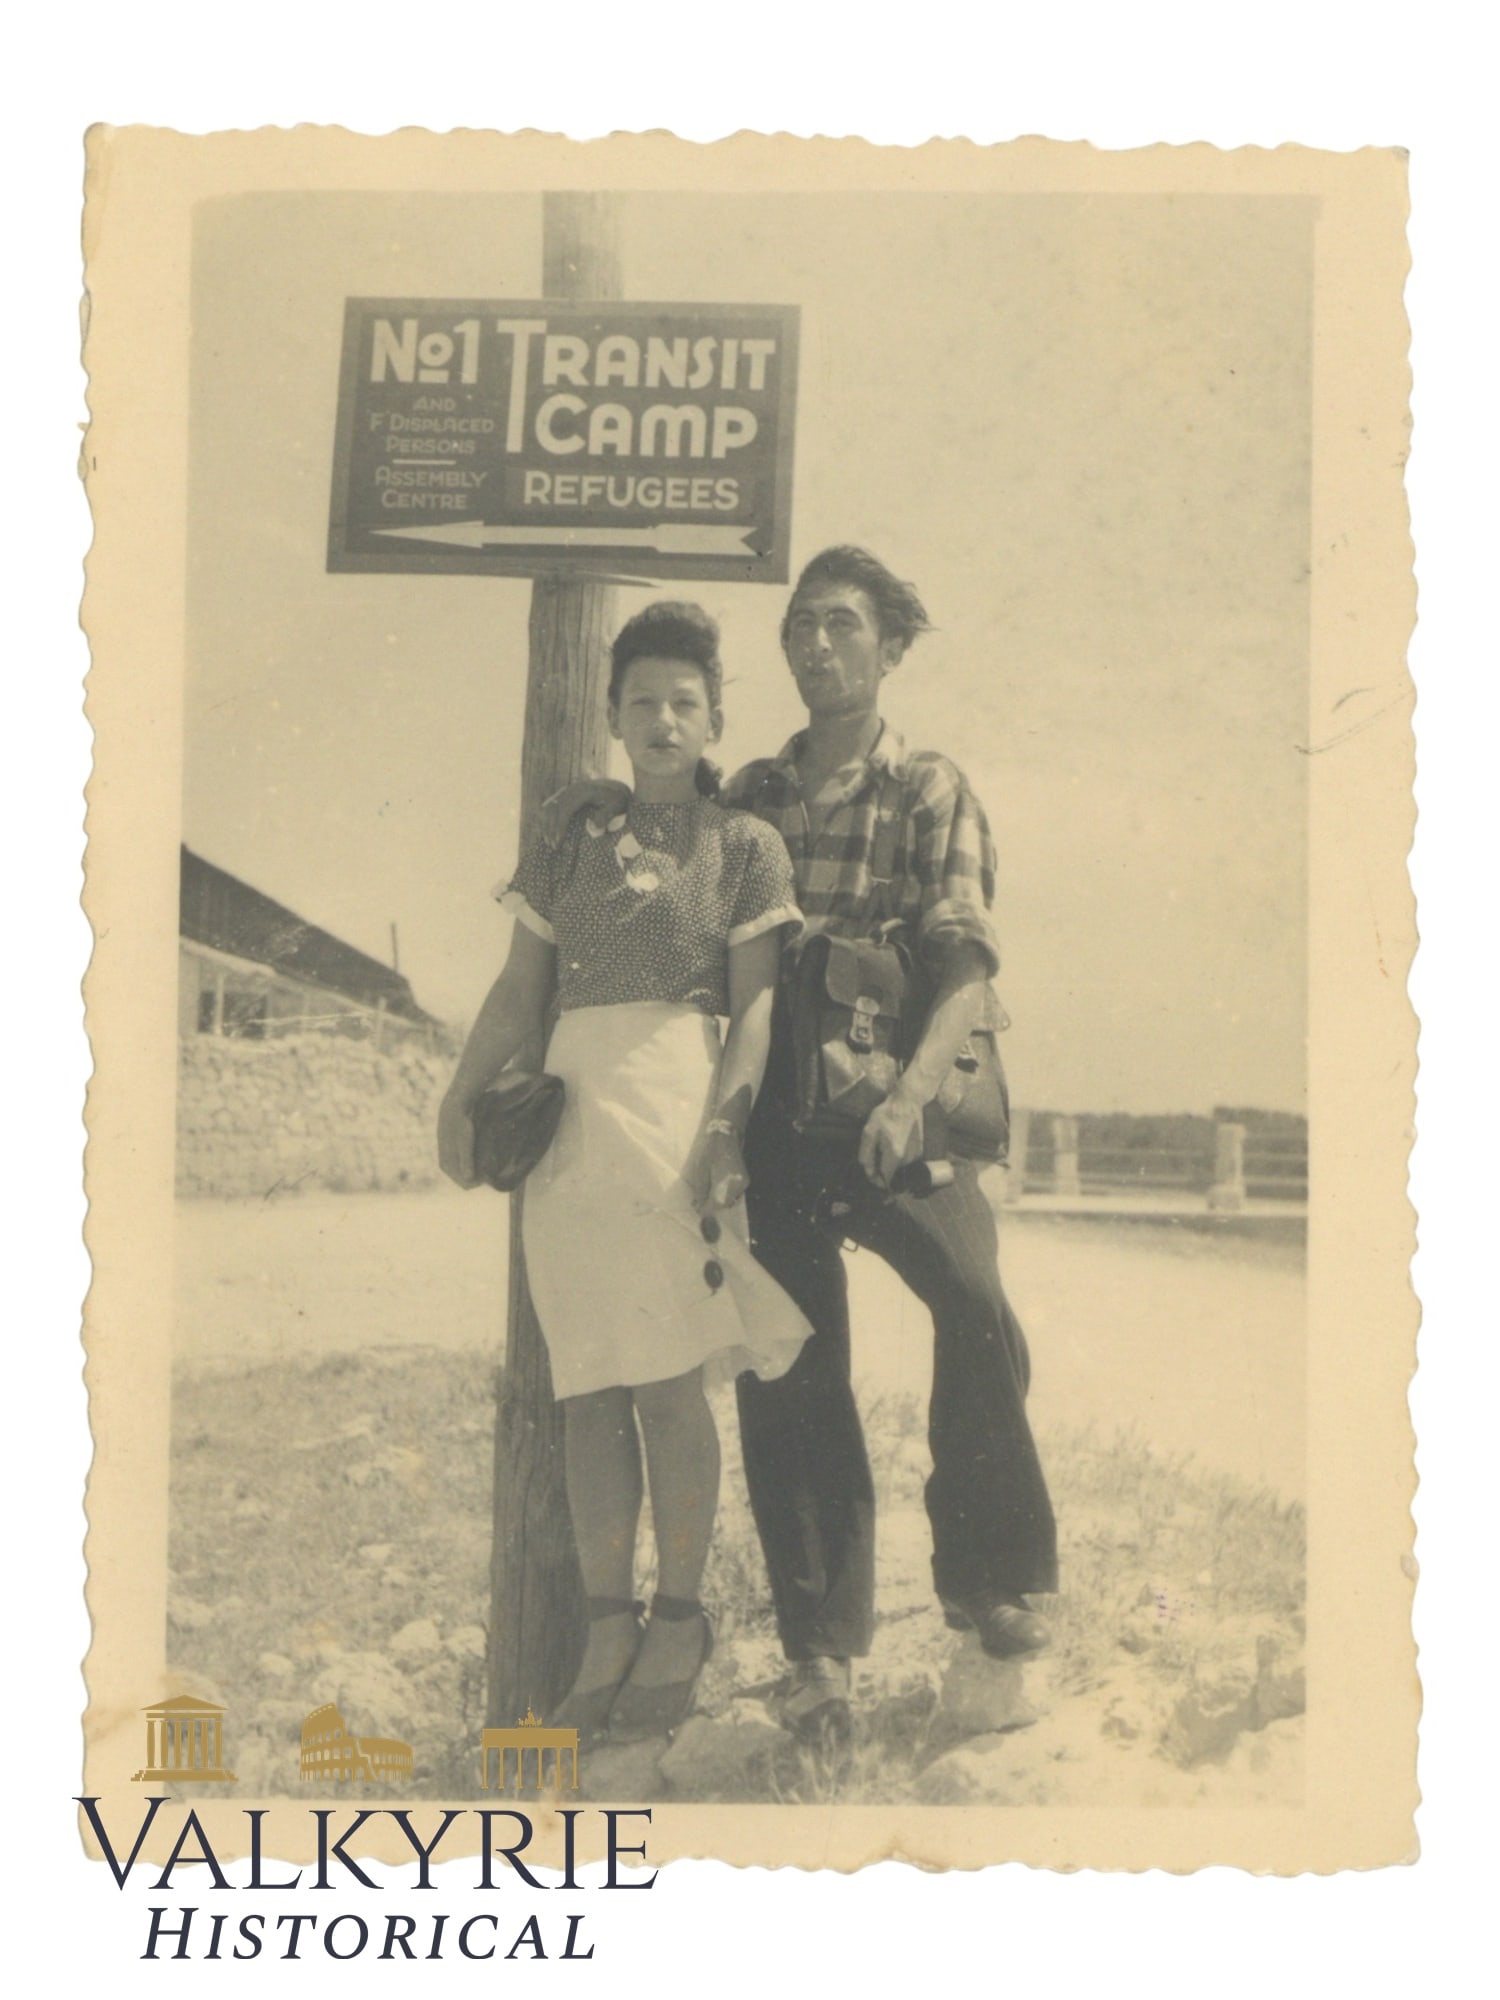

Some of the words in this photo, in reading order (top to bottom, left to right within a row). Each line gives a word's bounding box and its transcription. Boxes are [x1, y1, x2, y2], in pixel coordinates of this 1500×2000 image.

[497, 319, 776, 453] TRANSIT
[412, 396, 457, 412] AND
[389, 412, 495, 434] DISPLACED
[534, 393, 758, 458] CAMP
[385, 435, 476, 455] PERSONS
[375, 466, 488, 488] ASSEMBLY
[380, 489, 468, 510] CENTRE
[523, 469, 739, 511] REFUGEES
